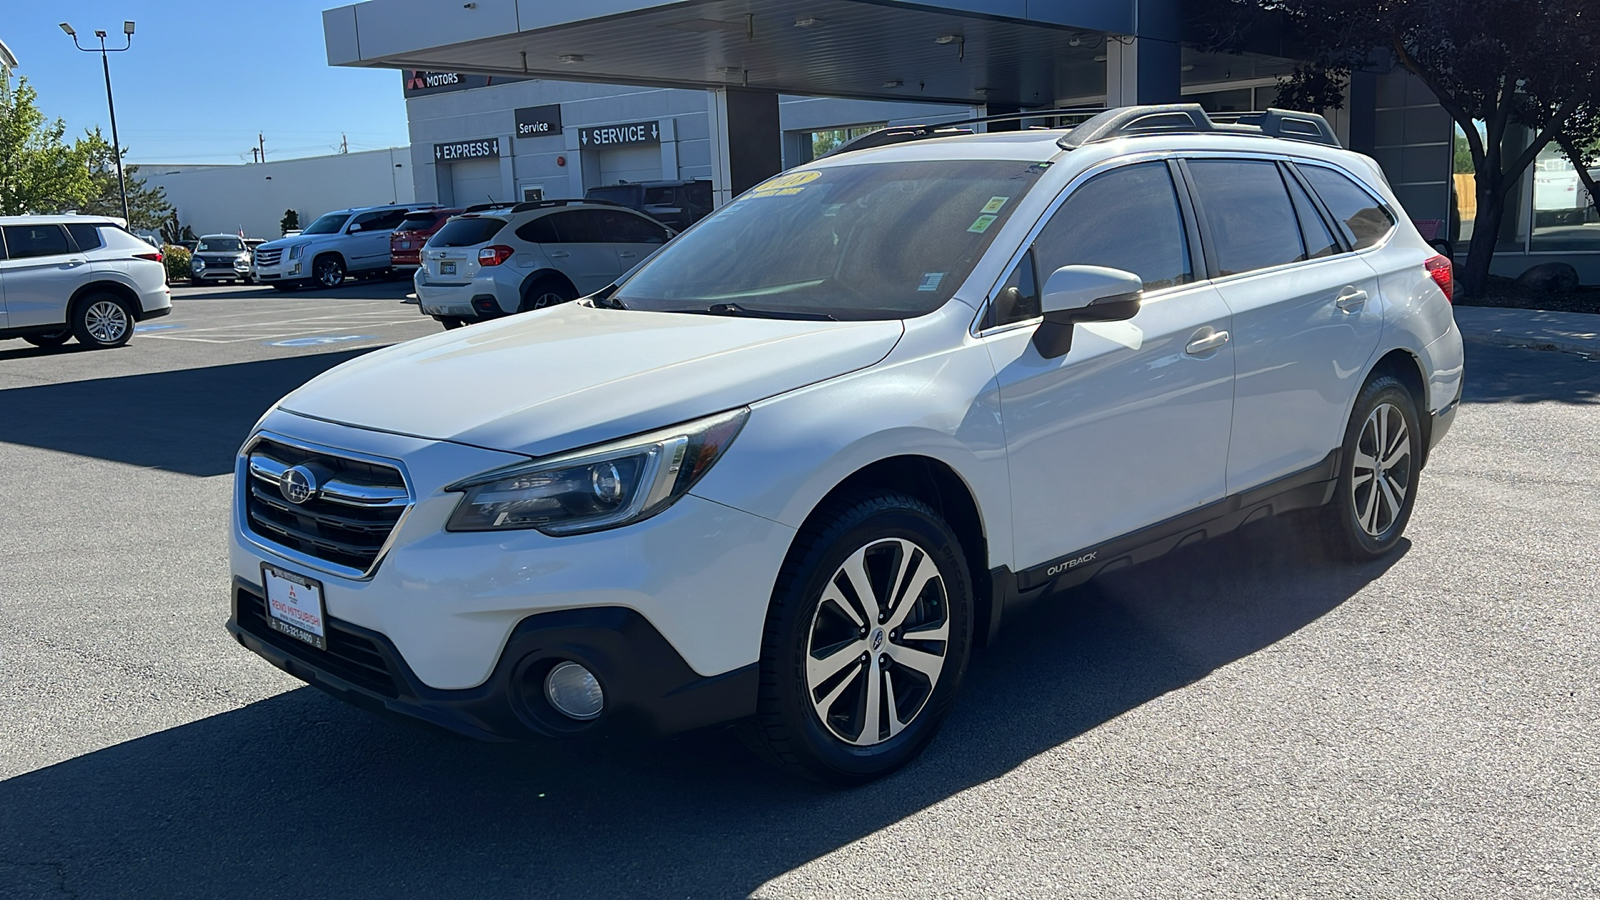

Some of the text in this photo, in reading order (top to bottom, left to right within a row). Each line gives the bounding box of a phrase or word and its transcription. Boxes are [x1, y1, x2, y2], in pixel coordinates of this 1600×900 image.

[426, 73, 459, 87] MOTORS
[519, 121, 549, 134] Service
[593, 125, 646, 145] SERVICE
[443, 142, 490, 159] EXPRESS
[1046, 551, 1098, 576] OUTBACK
